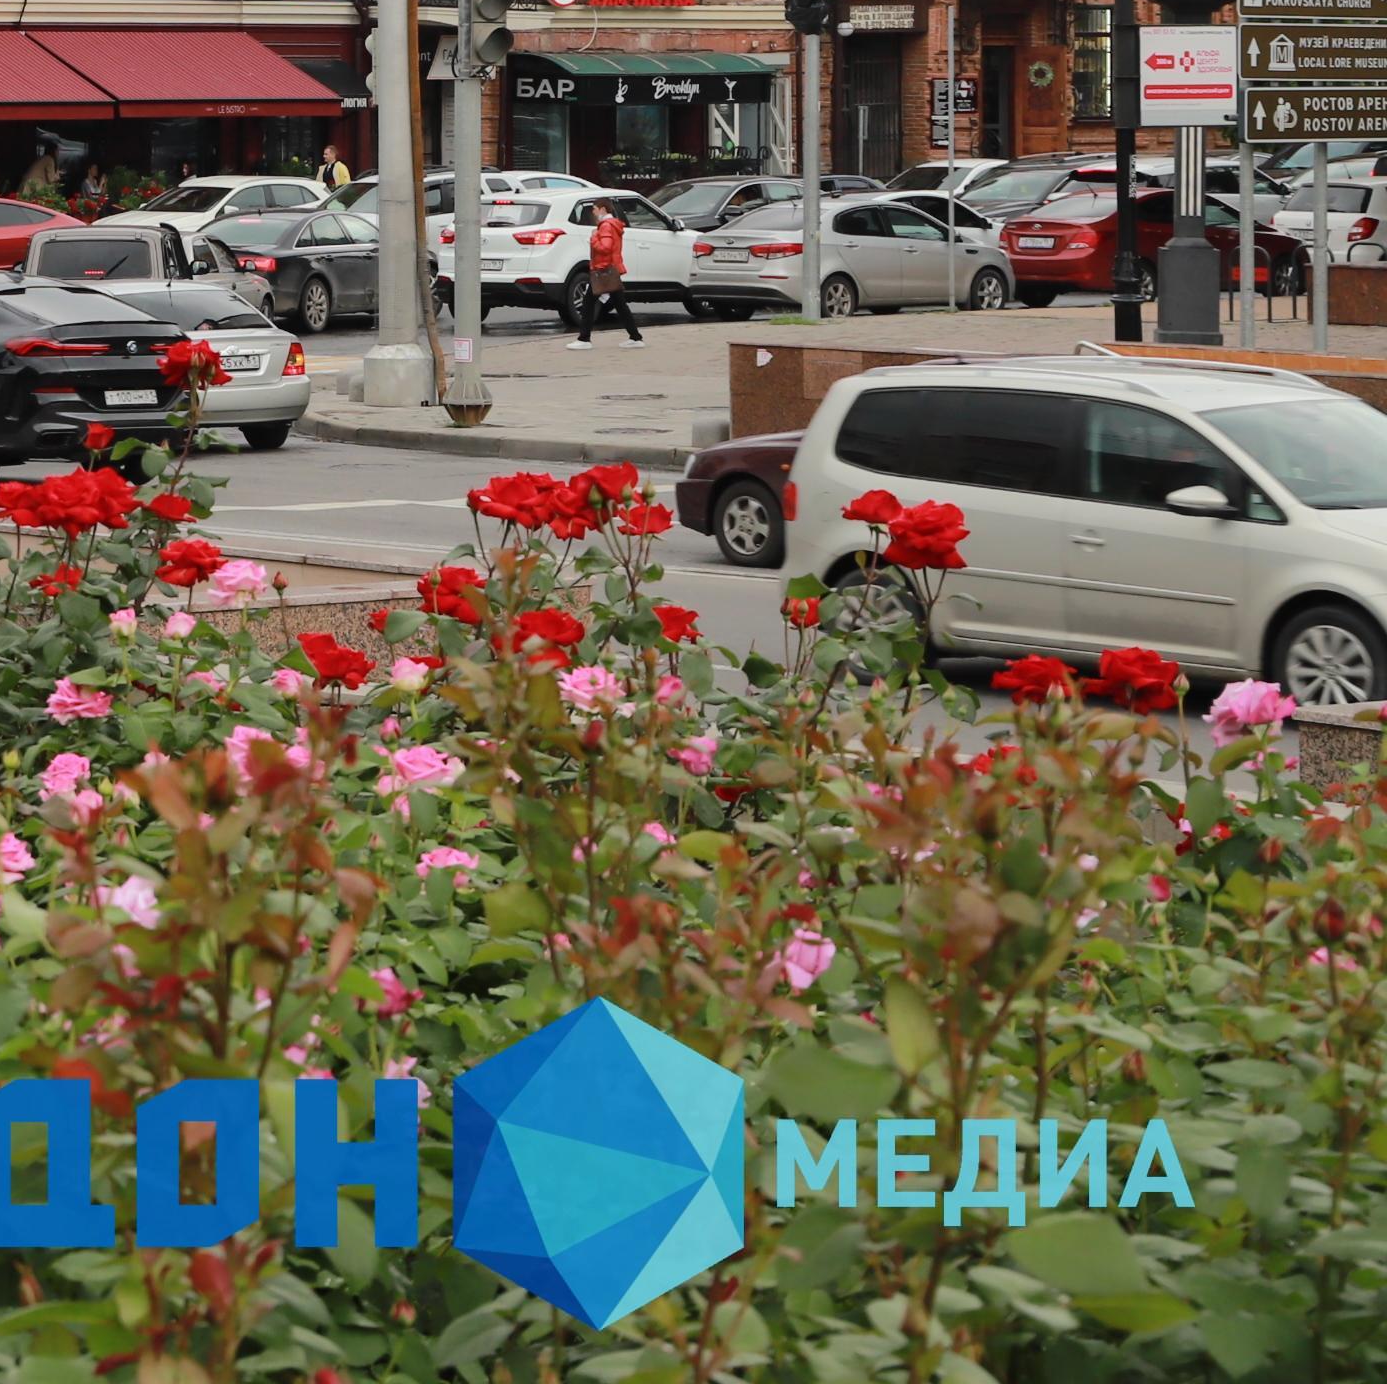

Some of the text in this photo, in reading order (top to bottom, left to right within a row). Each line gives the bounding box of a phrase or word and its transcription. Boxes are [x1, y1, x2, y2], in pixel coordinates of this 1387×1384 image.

[1298, 36, 1329, 48] МУЗЕЙ
[1298, 57, 1327, 68] LOCAL
[1329, 57, 1352, 68] LORE
[516, 78, 575, 98] БАР
[652, 76, 700, 103] Brooklyn
[341, 97, 367, 108] ЛОГИЯ
[1303, 97, 1354, 111] РОСТОВ
[1303, 118, 1354, 132] ROSTOV
